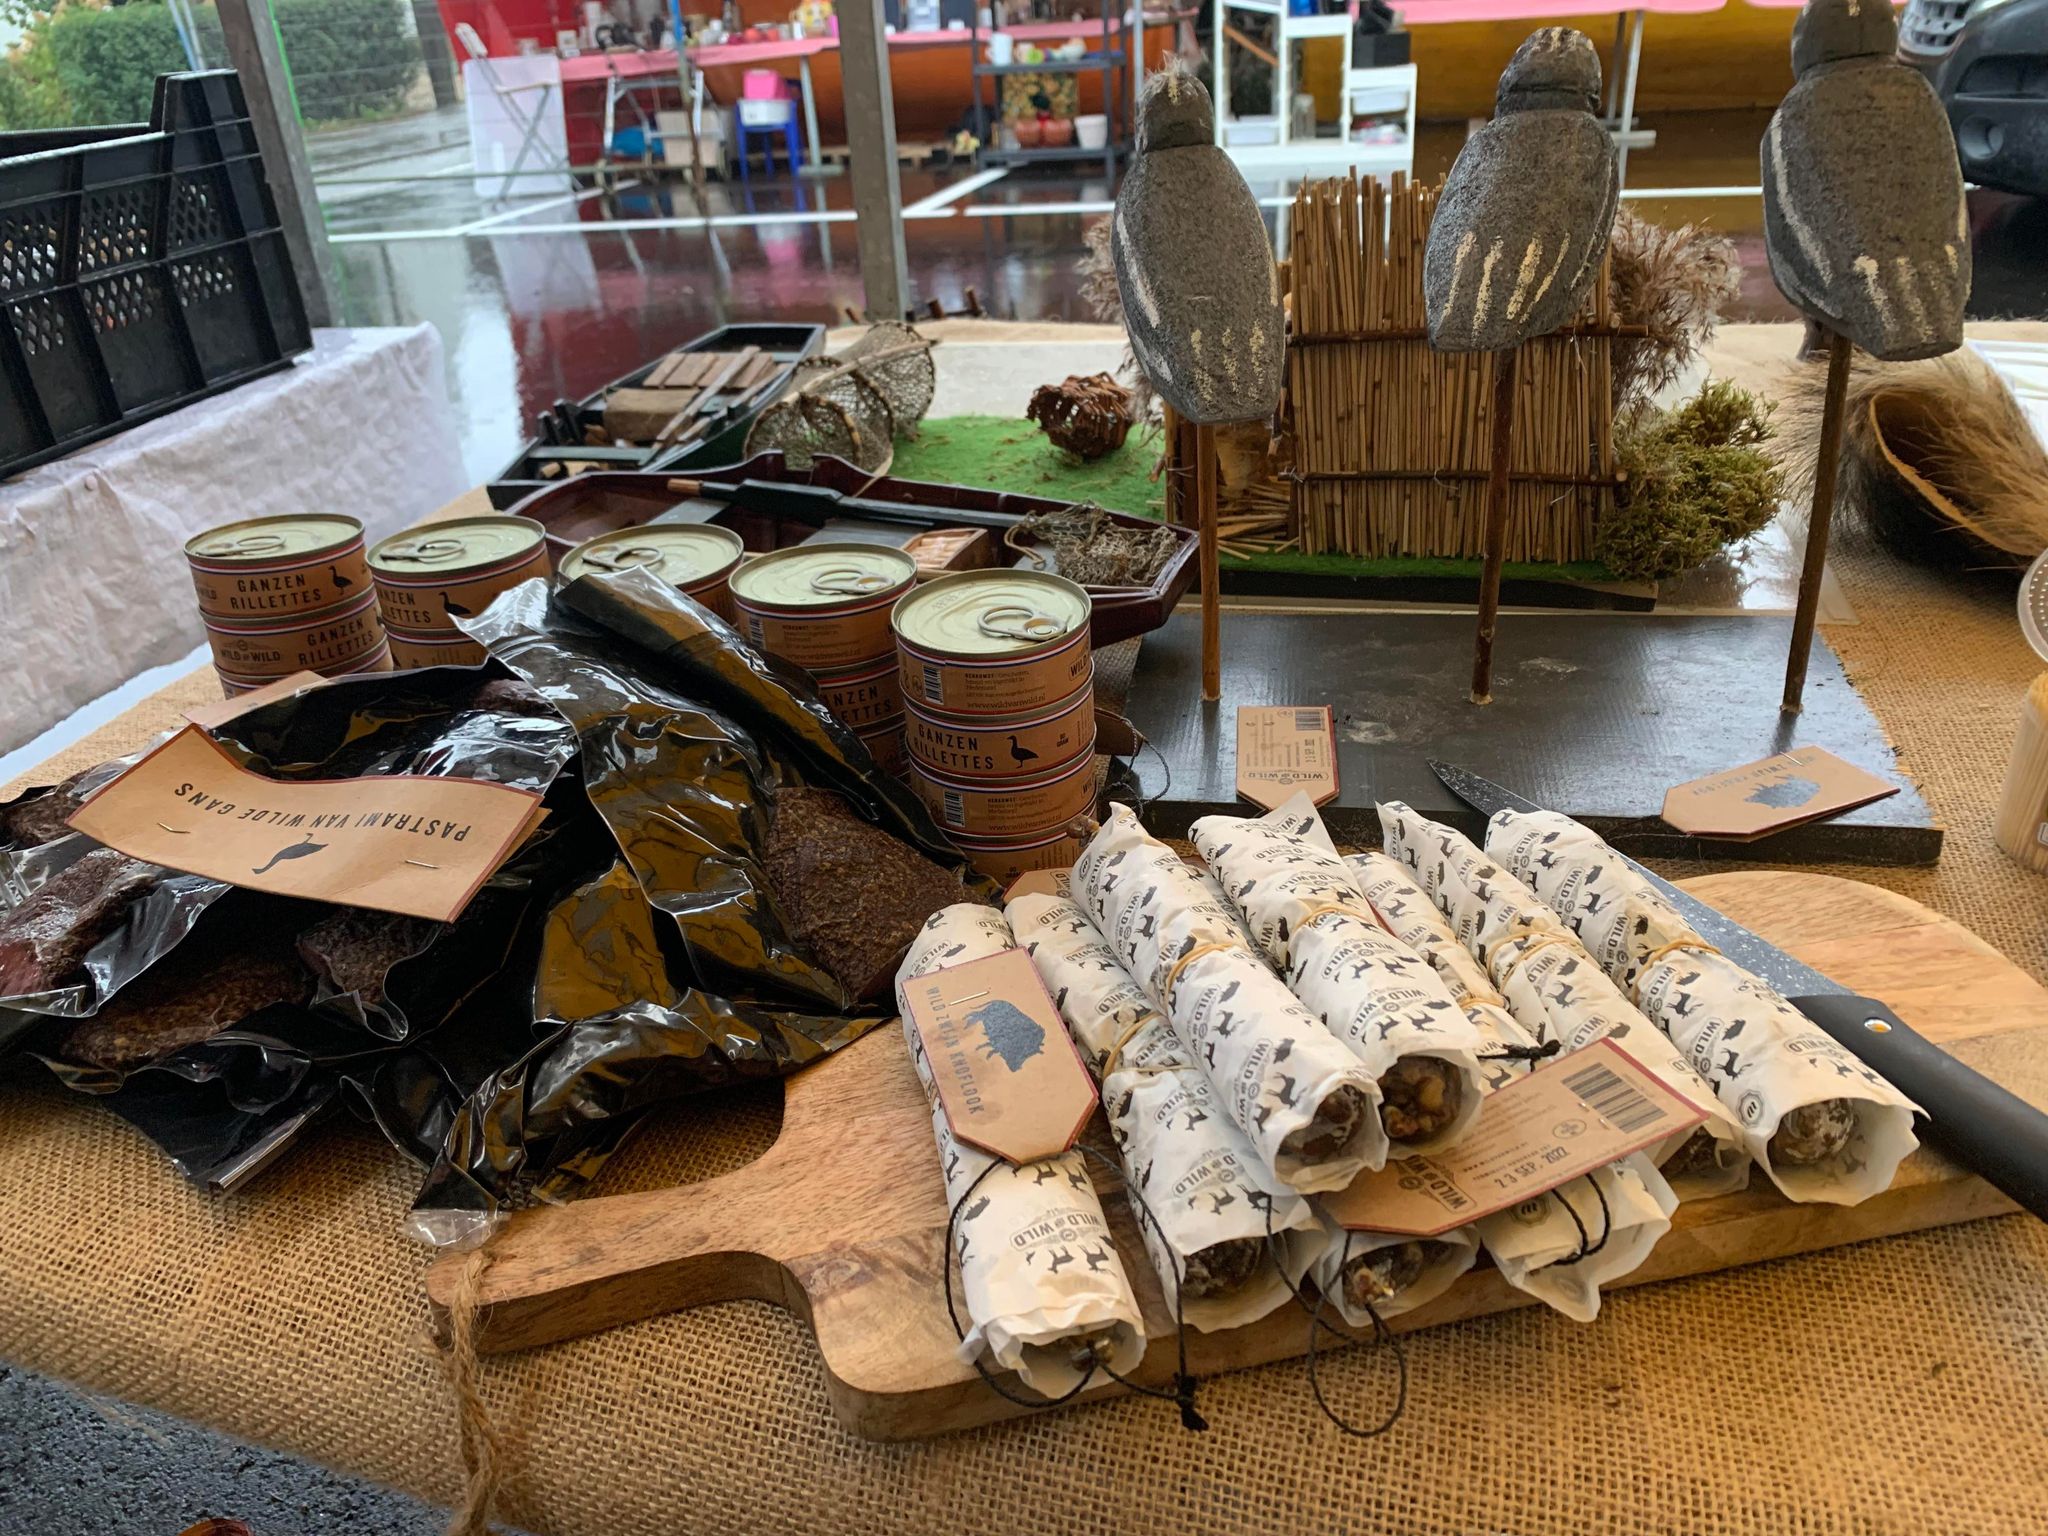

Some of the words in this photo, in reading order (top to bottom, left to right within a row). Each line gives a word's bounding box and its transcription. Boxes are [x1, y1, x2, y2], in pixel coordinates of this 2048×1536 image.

[237, 574, 305, 593] GANZEN
[378, 589, 415, 605] ANZEN
[230, 588, 322, 610] RILLETTES
[307, 617, 364, 647] GANZEN
[251, 651, 280, 662] WILD
[299, 631, 374, 665] RILLETTES
[918, 723, 979, 750] GANZEN
[913, 737, 994, 770] RILLETTES
[174, 782, 236, 815] GANS
[237, 808, 306, 828] WILDE
[309, 814, 351, 829] VAN
[354, 812, 472, 842] PASTRAMI
[1517, 831, 1540, 854] WILD
[1153, 857, 1181, 867] WILD
[1279, 876, 1310, 890] WILD
[1368, 879, 1397, 898] WILD
[1560, 869, 1582, 898] WILD
[1040, 907, 1069, 925] WILD
[1120, 894, 1140, 925] WILD
[1402, 925, 1427, 943] WIL
[1460, 918, 1472, 945] WIL
[1608, 915, 1628, 948] WILD
[921, 942, 949, 963] WILD
[1363, 942, 1394, 951] WILD
[1323, 948, 1353, 976] WILD
[1528, 956, 1557, 983] WILD
[1650, 966, 1677, 996] WILD
[926, 985, 946, 1012] WILD
[1099, 989, 1129, 1014] WILD
[1194, 987, 1218, 1021] WILD
[1389, 990, 1427, 1001] WILD
[935, 1014, 960, 1049] ZWIJN
[1350, 1003, 1377, 1036] WILD
[1574, 1016, 1605, 1046] WILD
[1695, 1021, 1721, 1055] WILD
[1788, 1041, 1820, 1052] WILD
[1243, 1042, 1270, 1079] WILD
[948, 1048, 985, 1115] KNOFLOOK
[1156, 1091, 1188, 1121] WILD
[1175, 1167, 1212, 1194] WILD
[1430, 1180, 1468, 1209] WILD
[1068, 1213, 1100, 1226] WILD
[1013, 1222, 1055, 1247] WILD
